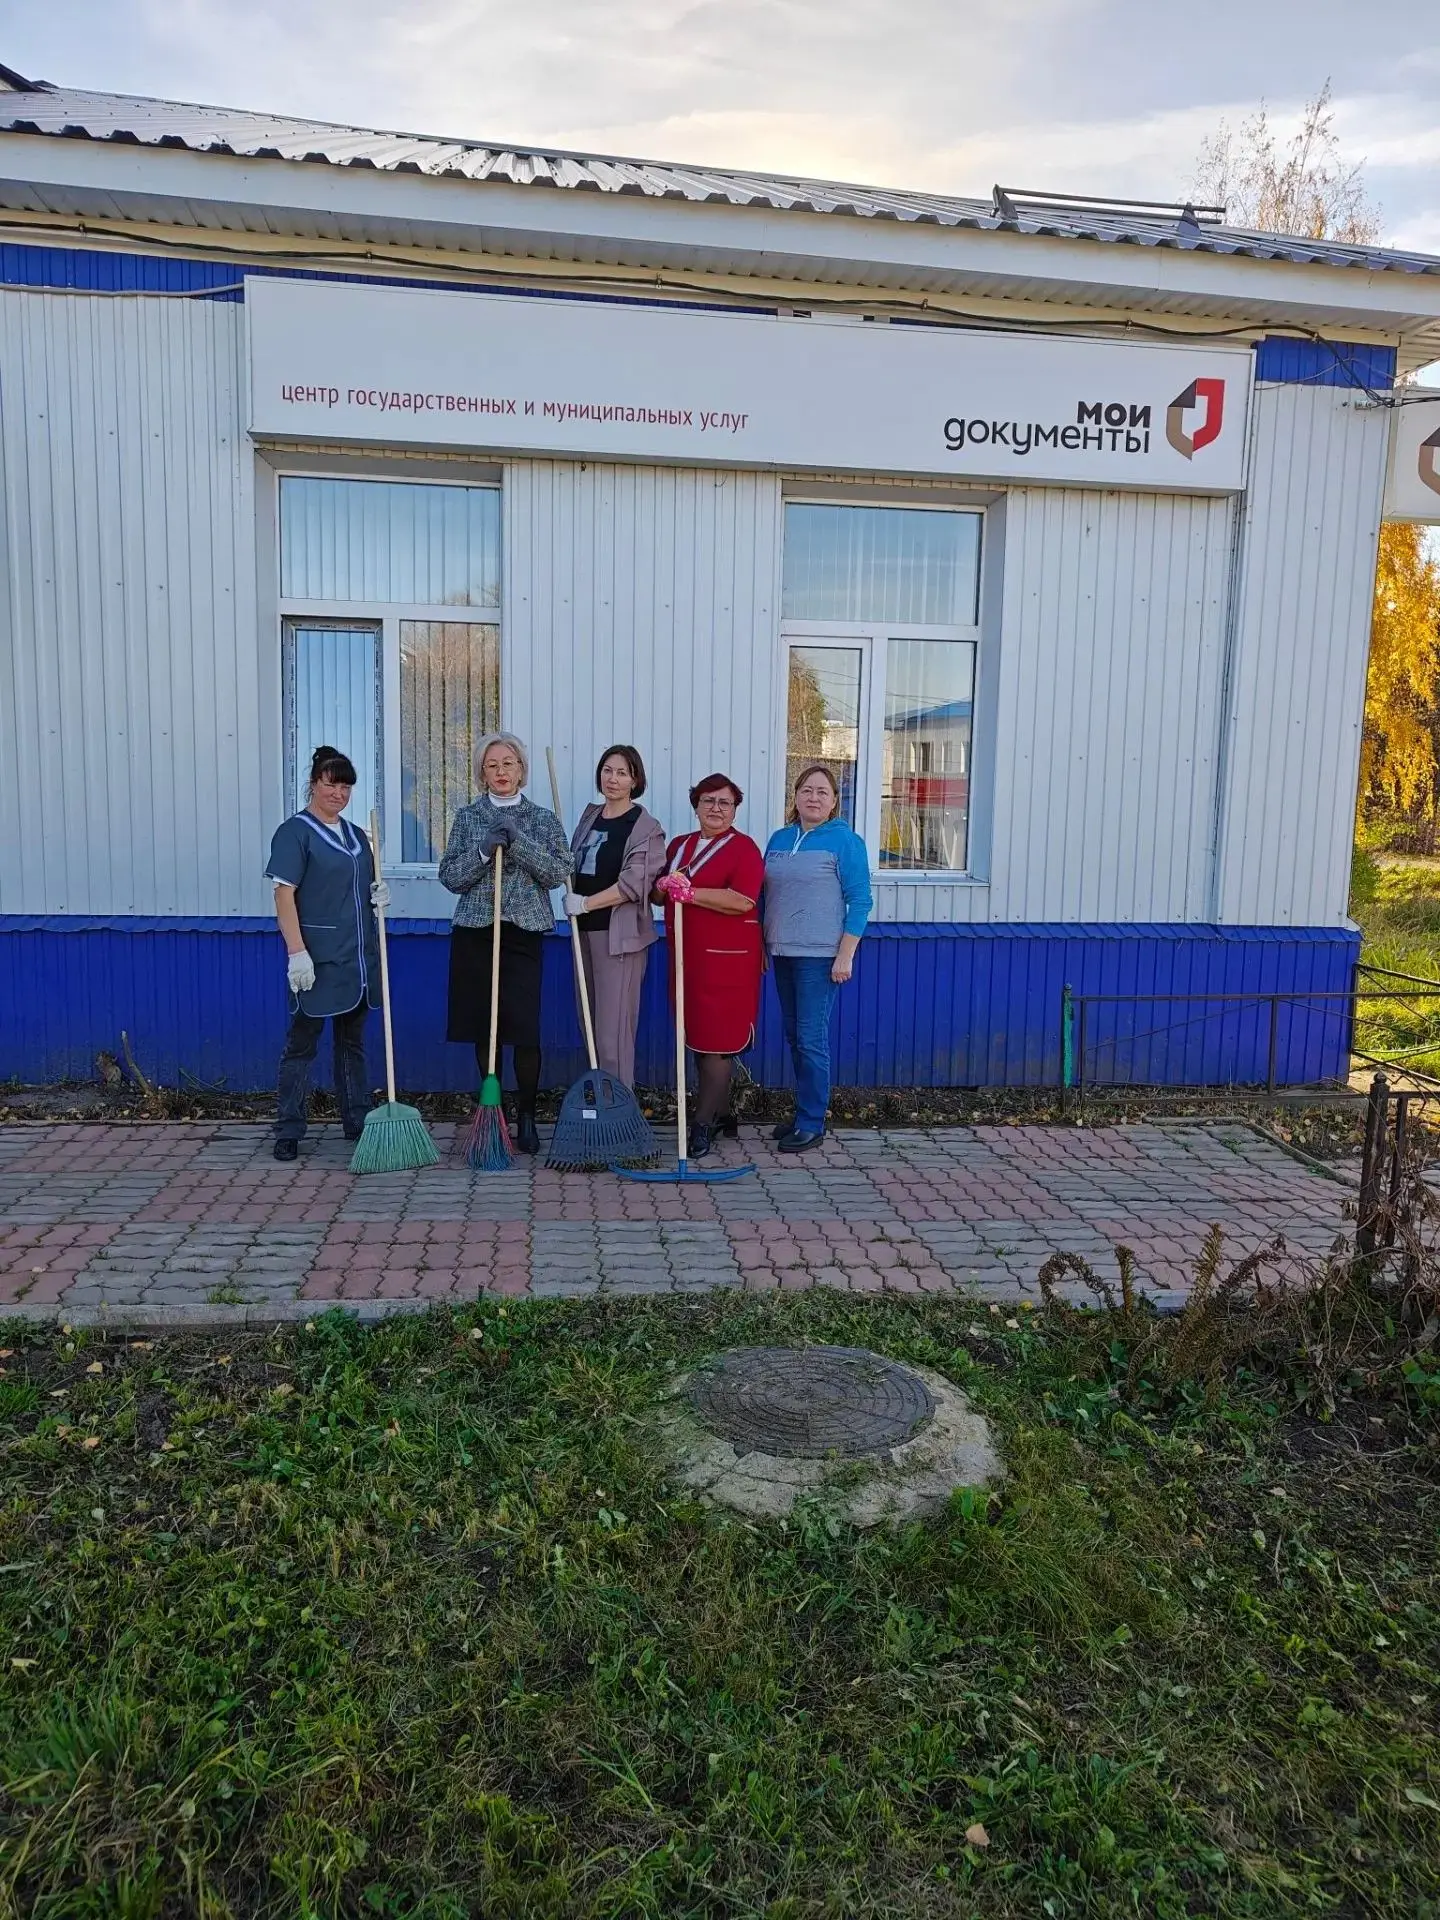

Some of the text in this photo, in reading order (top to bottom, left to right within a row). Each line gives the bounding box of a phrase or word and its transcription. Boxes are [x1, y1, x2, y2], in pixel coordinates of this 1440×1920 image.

[282, 384, 749, 434] центр государственных и муниципальных услуг
[1076, 400, 1152, 429] мои
[943, 417, 1150, 456] документы
